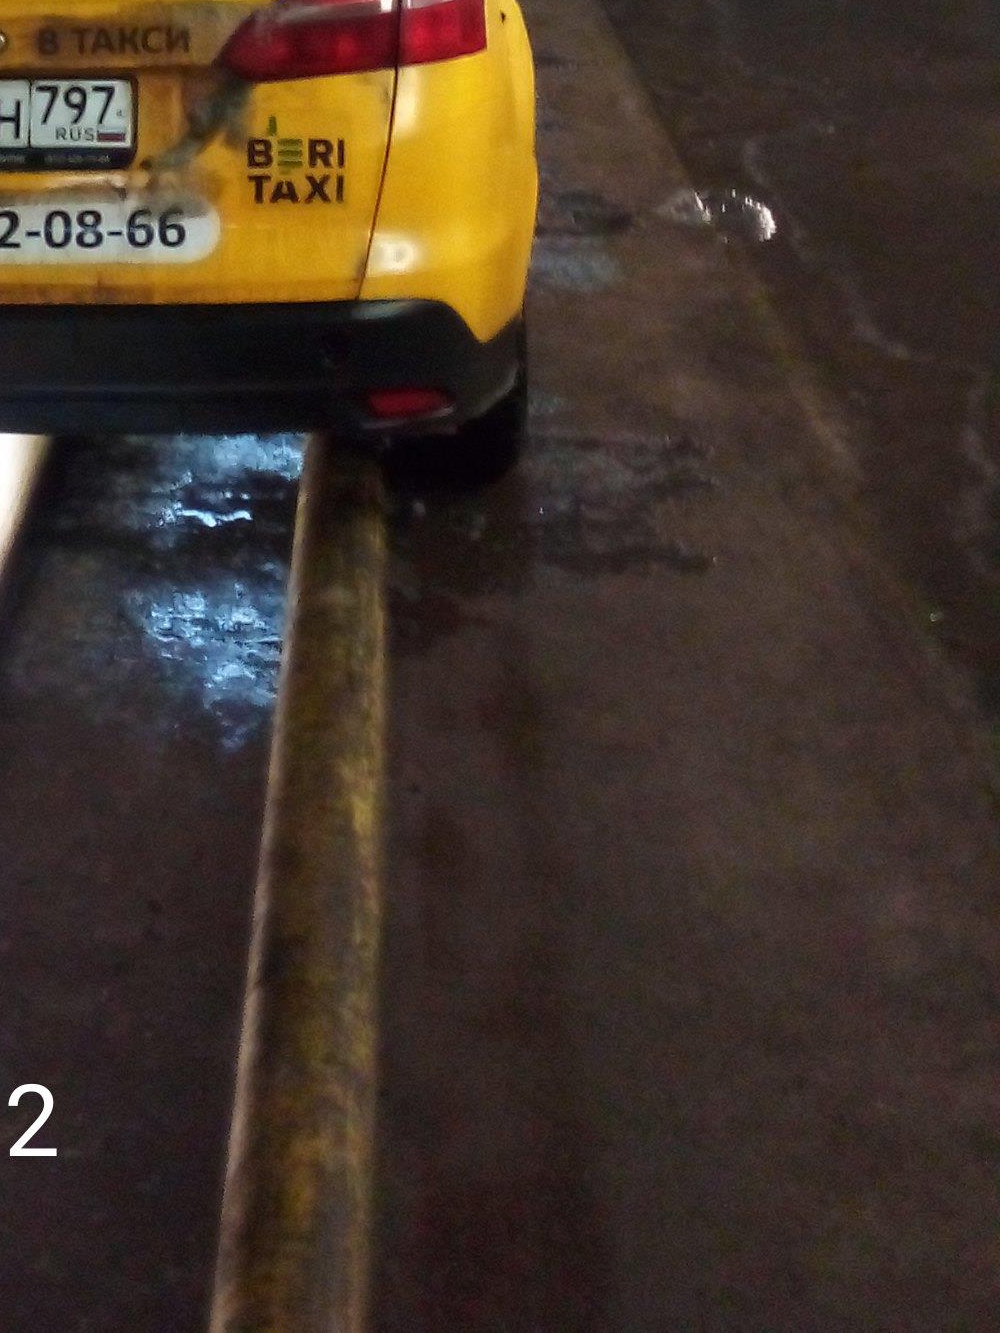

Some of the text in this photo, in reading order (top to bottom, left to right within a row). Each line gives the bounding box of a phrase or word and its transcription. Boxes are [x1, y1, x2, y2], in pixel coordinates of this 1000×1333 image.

[71, 25, 191, 55] ТАКСИ
[35, 85, 116, 124] 797
[56, 127, 96, 142] RUS
[247, 137, 345, 169] BERI
[247, 174, 344, 204] TAXI
